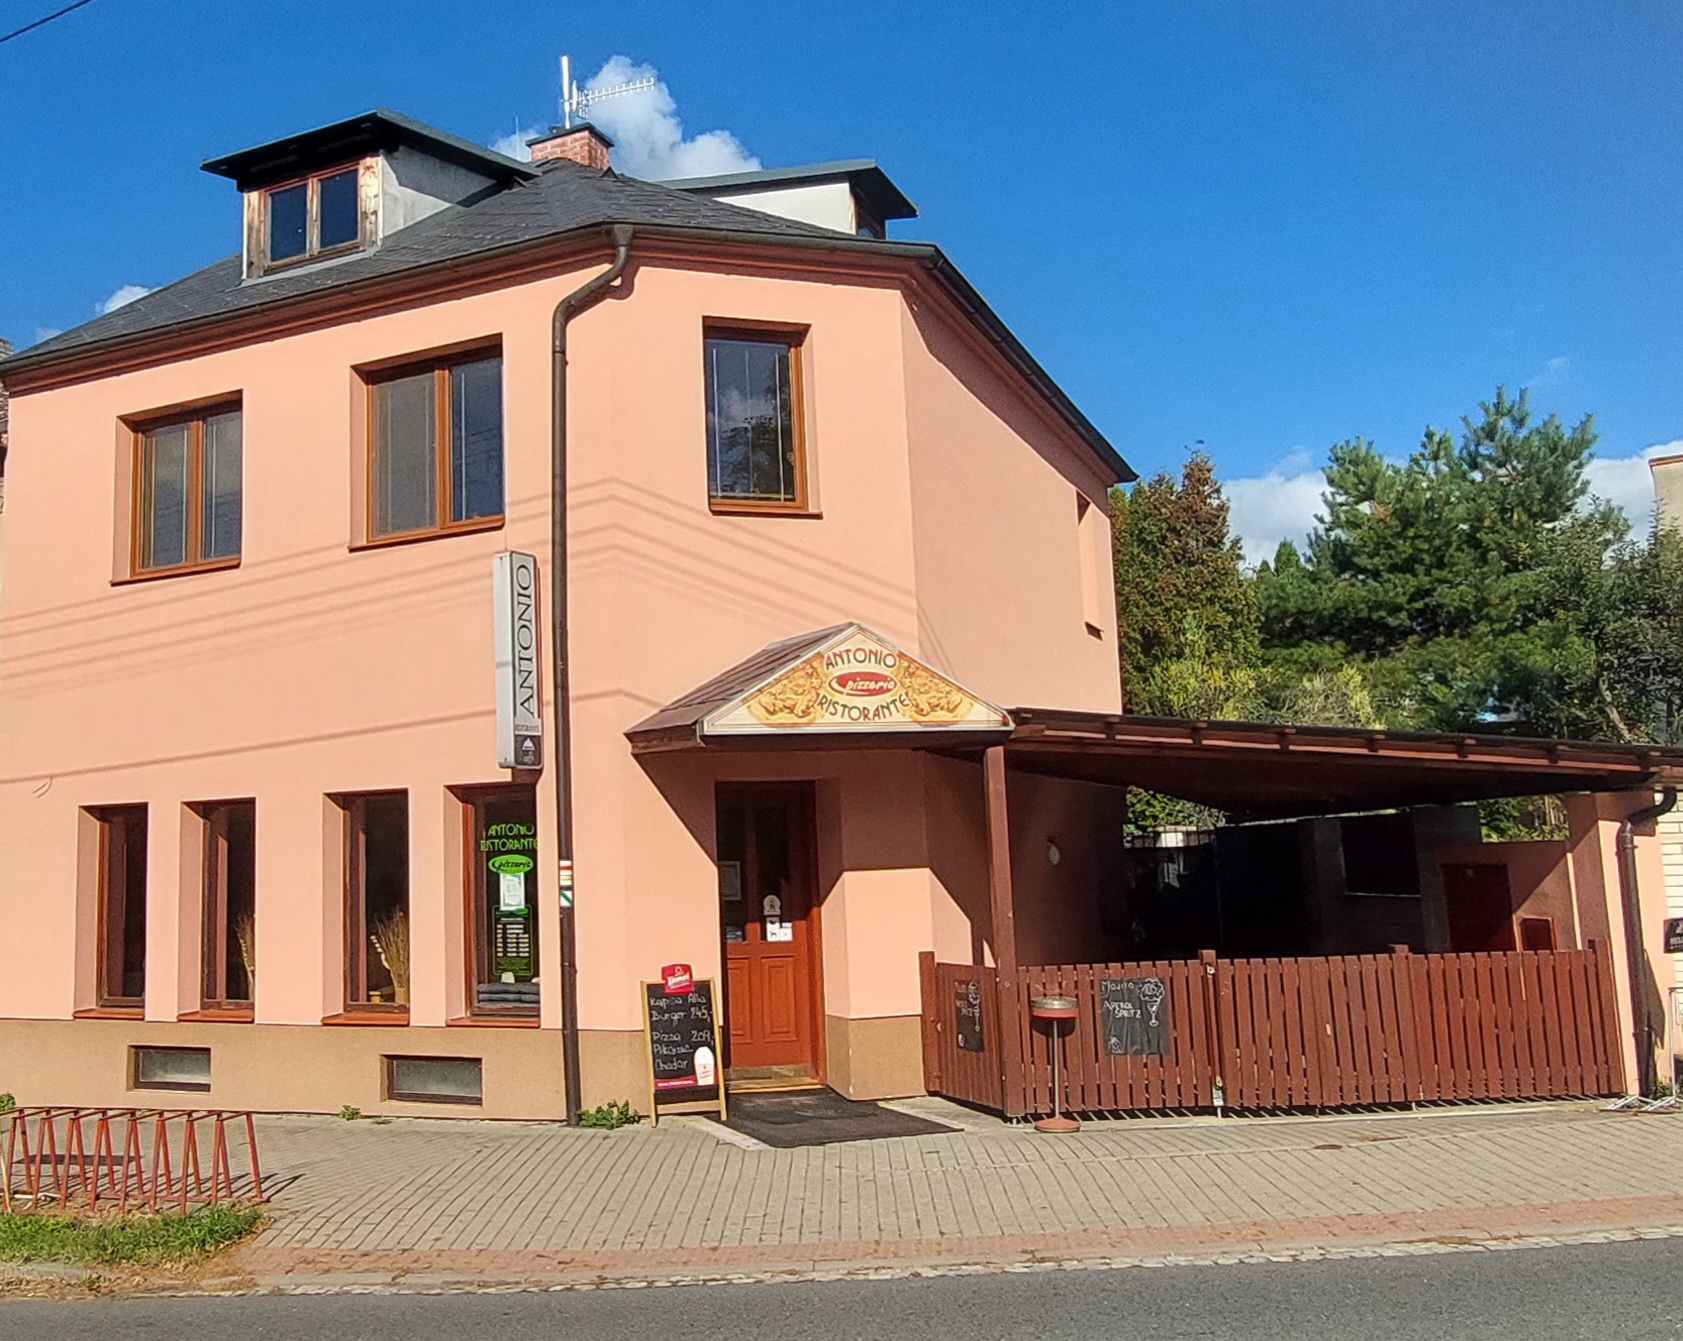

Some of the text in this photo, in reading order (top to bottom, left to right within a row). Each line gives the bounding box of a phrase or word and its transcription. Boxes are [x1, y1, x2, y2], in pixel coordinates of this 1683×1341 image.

[516, 564, 535, 718] ANTONIO
[824, 648, 897, 670] ANTONIO
[845, 677, 895, 692] pizzeria
[817, 693, 910, 722] RISTORANTE
[488, 823, 535, 837] ANTONIO
[1114, 1009, 1142, 1019] SPRITZ
